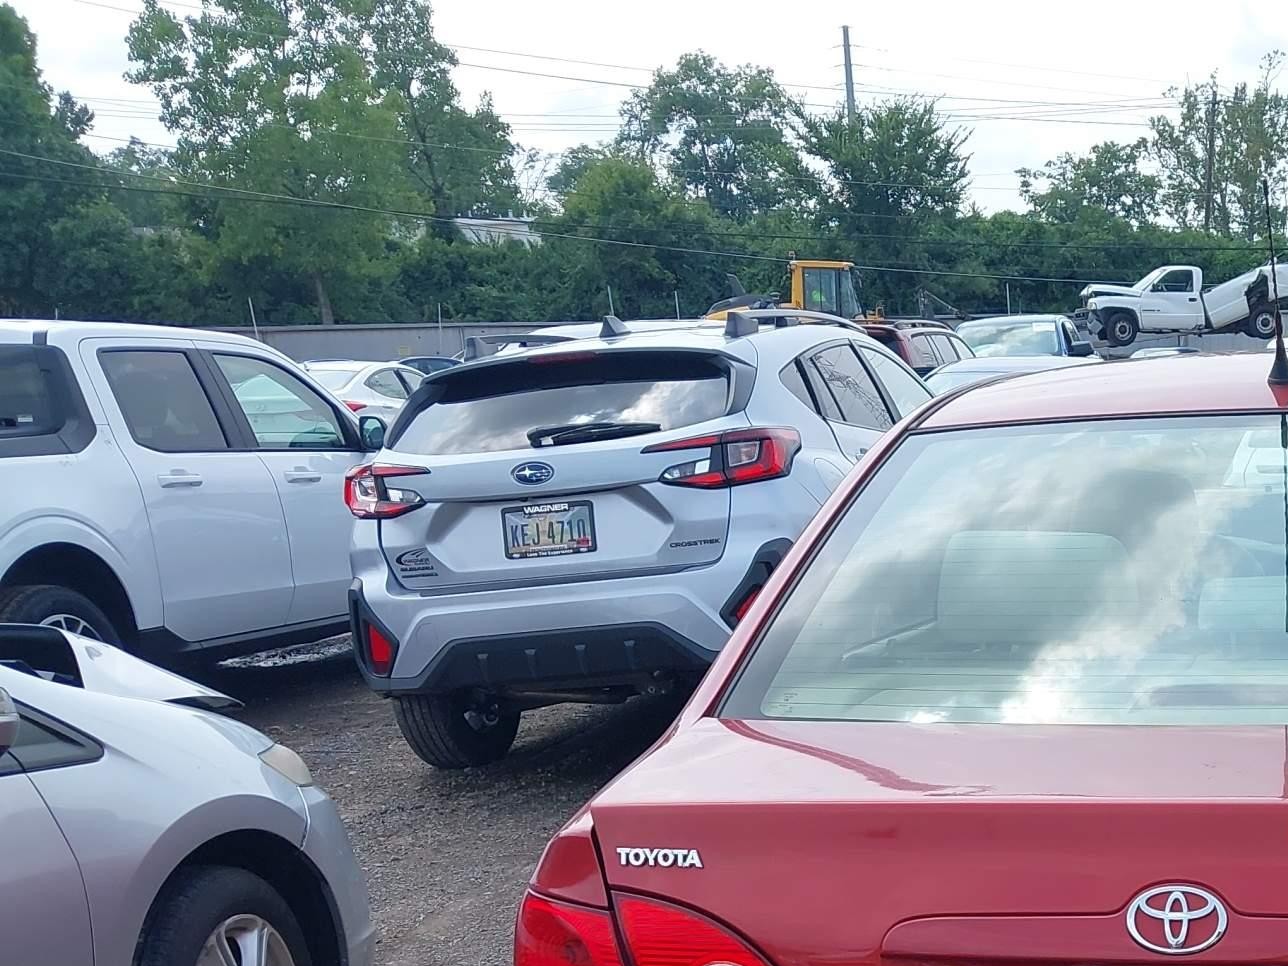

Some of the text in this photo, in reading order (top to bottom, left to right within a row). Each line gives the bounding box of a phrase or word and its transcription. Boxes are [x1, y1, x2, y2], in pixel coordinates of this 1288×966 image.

[523, 503, 568, 513] WAGNER
[510, 523, 541, 548] KEJ
[669, 538, 721, 548] CROSSTREK
[616, 847, 703, 868] TOYOTA
